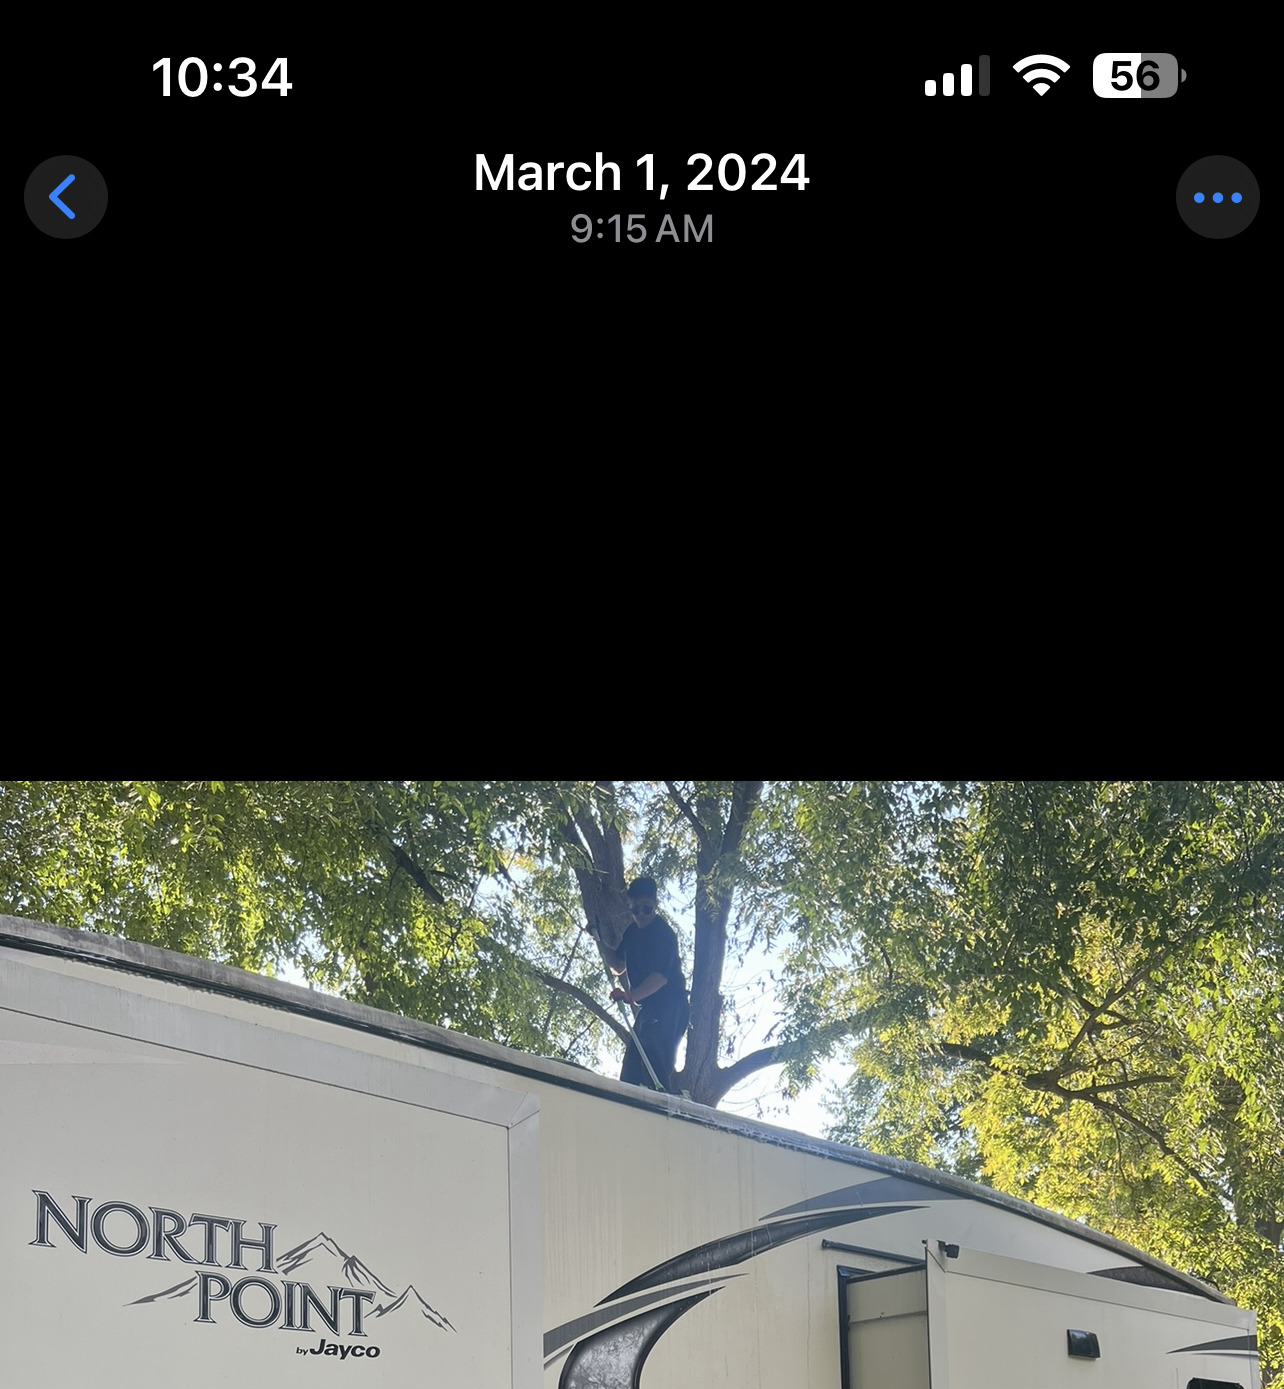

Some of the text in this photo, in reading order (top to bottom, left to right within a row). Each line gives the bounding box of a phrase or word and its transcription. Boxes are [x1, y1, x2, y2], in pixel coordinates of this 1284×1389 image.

[28, 1189, 278, 1275] NORTH
[193, 1270, 377, 1338] POINT
[296, 1338, 381, 1361] by Jayco
